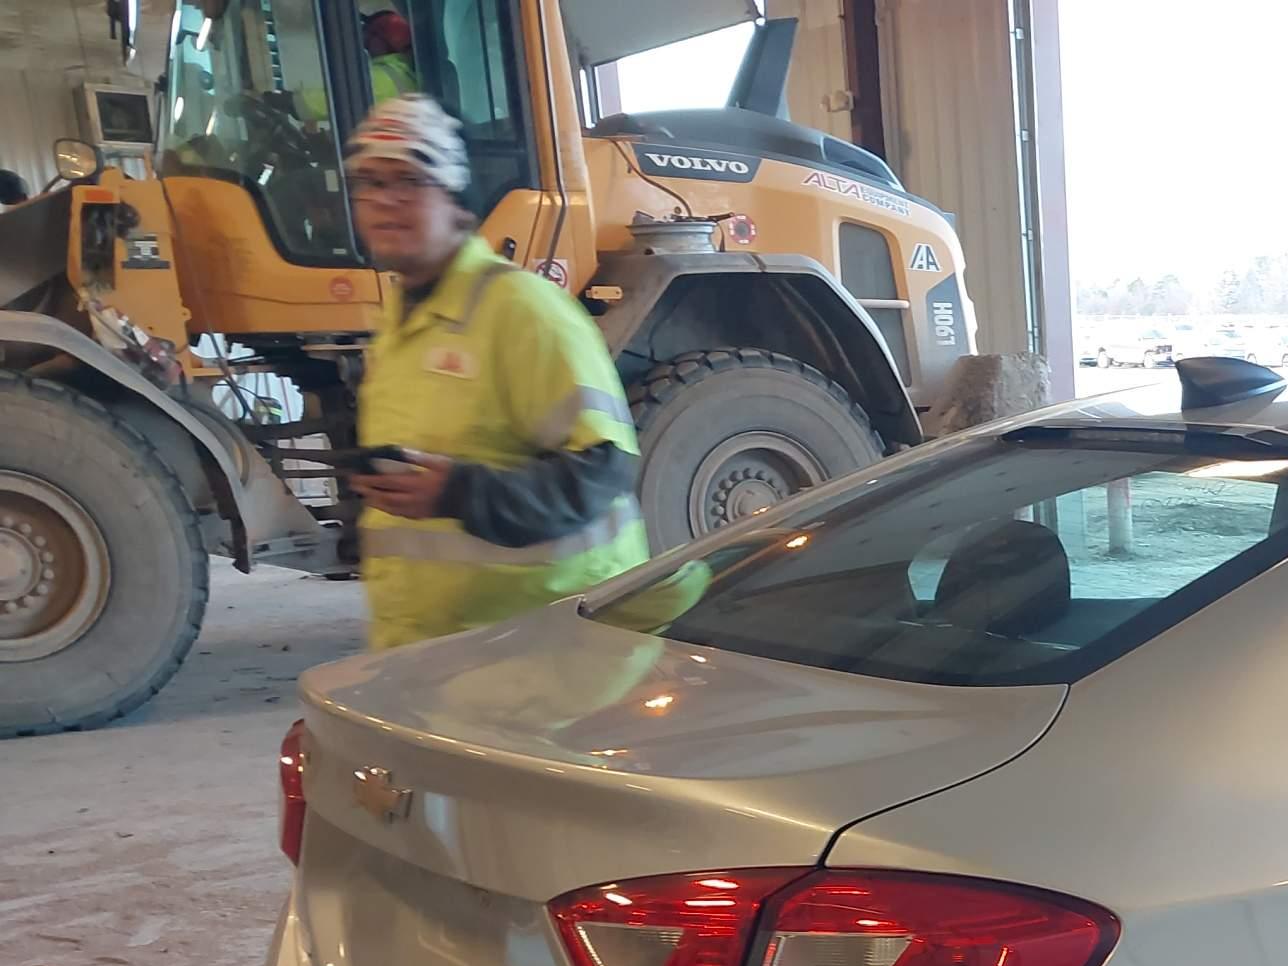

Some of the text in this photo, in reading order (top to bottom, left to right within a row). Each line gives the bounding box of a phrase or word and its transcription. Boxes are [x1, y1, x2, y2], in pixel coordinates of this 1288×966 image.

[645, 153, 749, 174] VOLVO
[803, 172, 861, 199] ALTA
[932, 302, 955, 346] L90H
